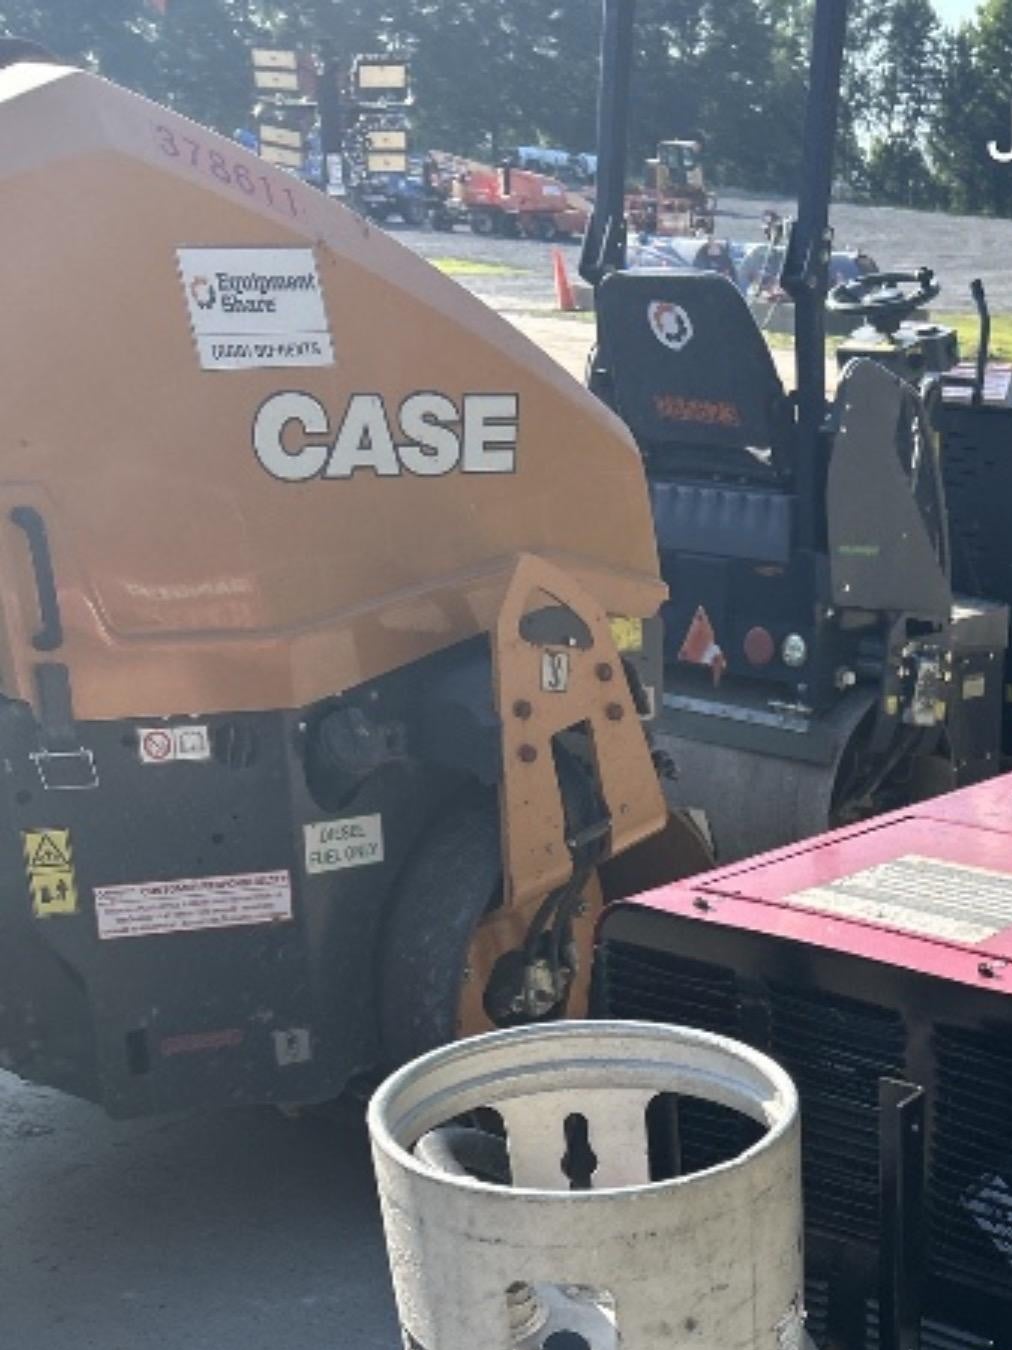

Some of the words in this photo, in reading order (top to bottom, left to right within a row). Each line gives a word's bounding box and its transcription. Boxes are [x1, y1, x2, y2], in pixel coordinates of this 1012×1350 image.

[214, 272, 316, 295] Equipment
[220, 293, 277, 313] Share
[252, 389, 519, 483] CASE
